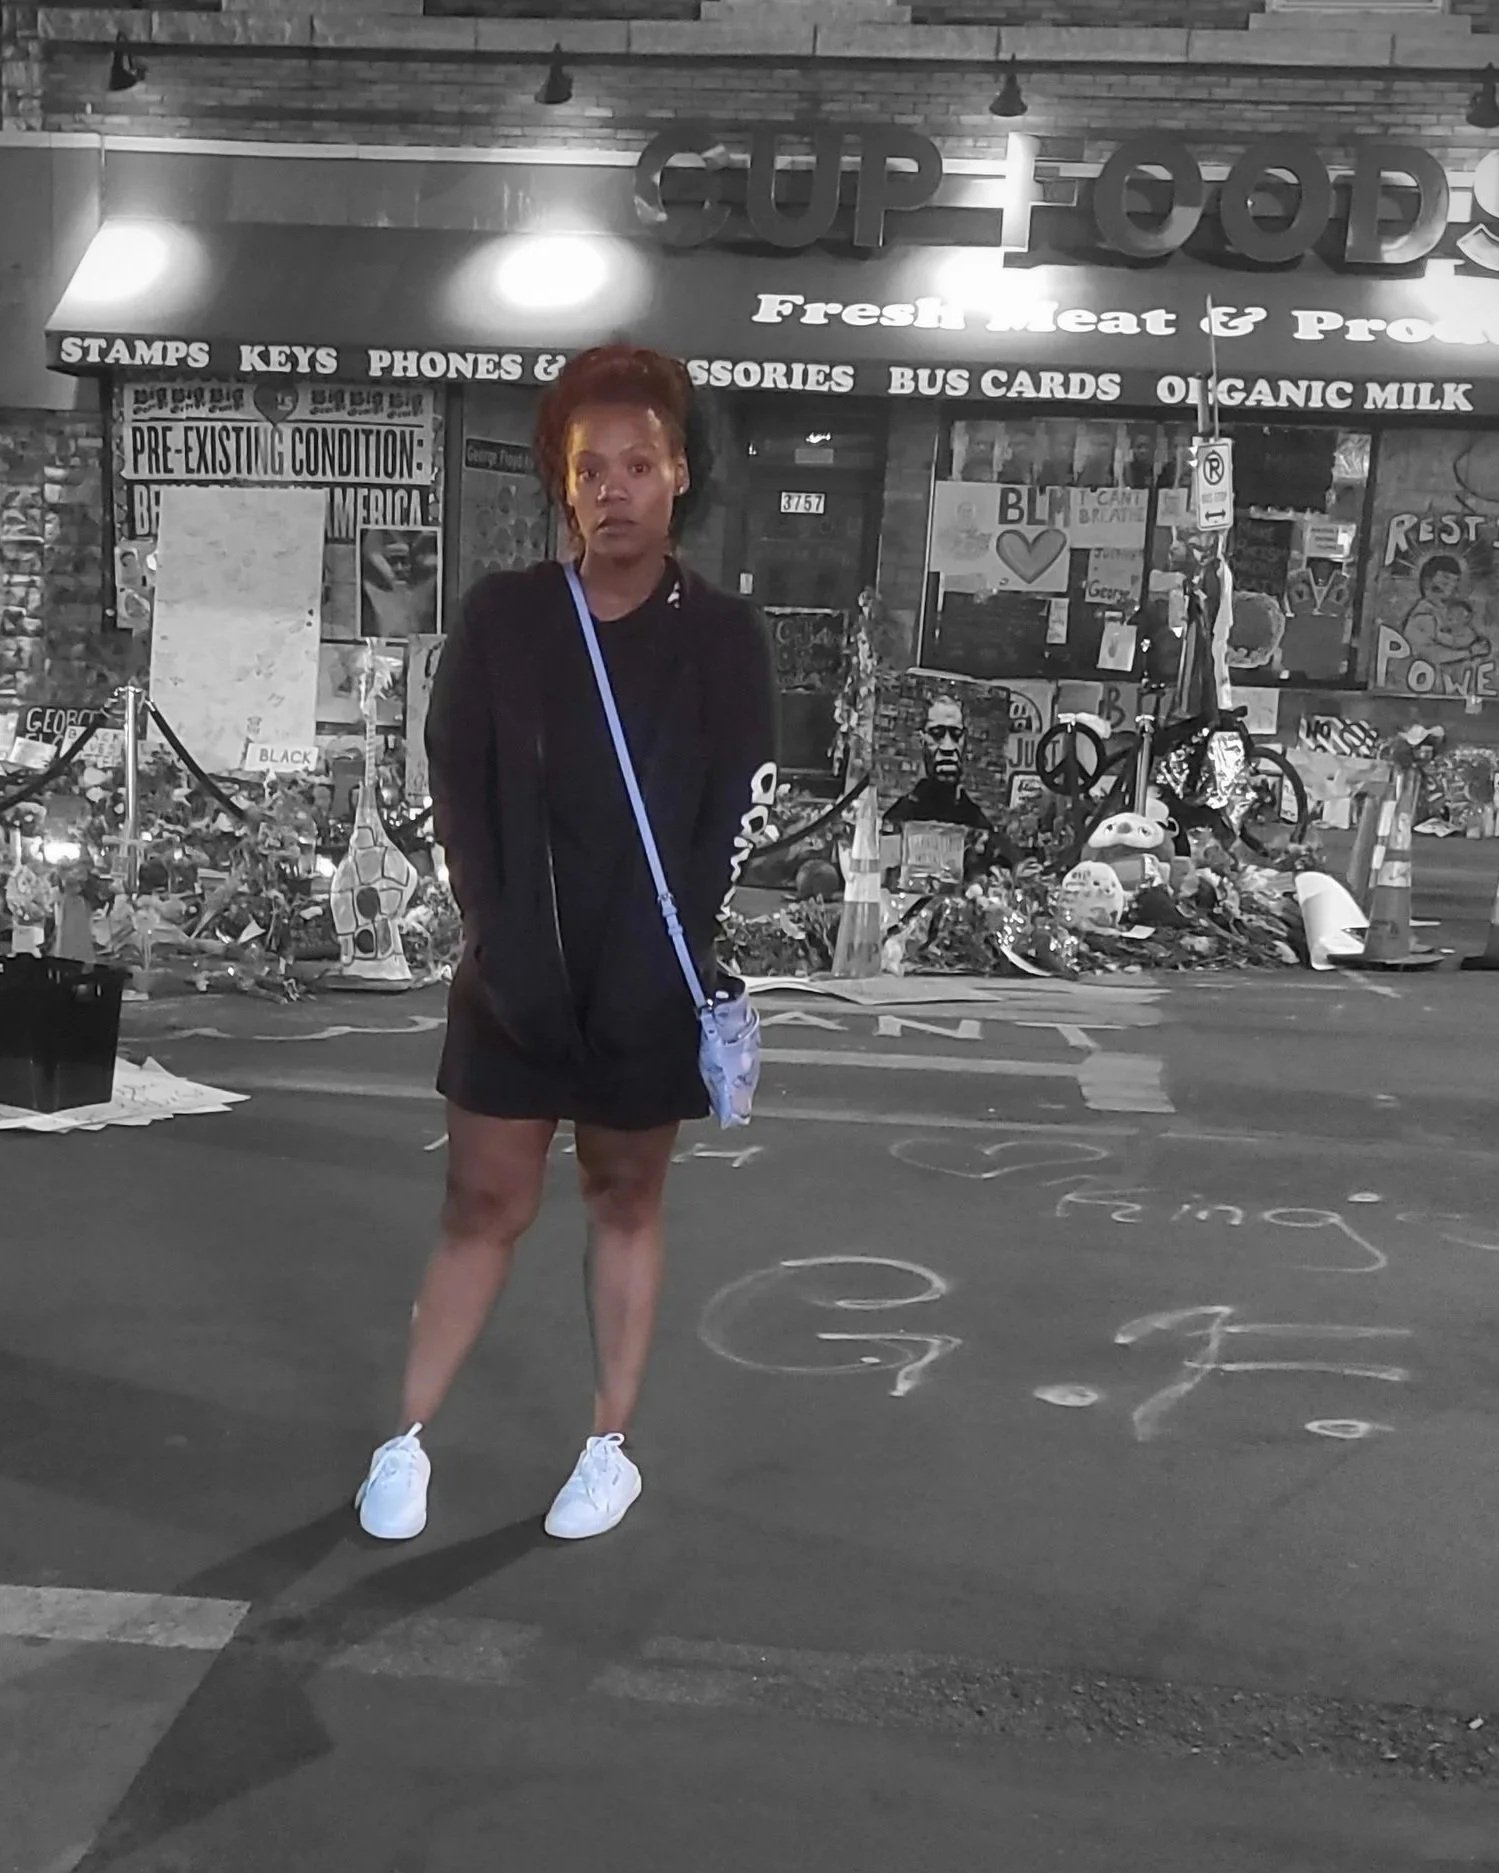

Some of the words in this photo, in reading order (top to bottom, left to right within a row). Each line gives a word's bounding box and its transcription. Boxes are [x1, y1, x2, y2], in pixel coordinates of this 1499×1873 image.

[634, 127, 943, 247] CUP
[752, 294, 965, 330] Fresh
[985, 300, 1176, 335] Meat
[1200, 306, 1267, 336] &
[61, 337, 209, 368] STAMPS
[239, 345, 338, 374] KEYS
[367, 349, 523, 380] PHONES
[533, 354, 567, 381] &
[687, 360, 855, 393] SSORIES
[888, 366, 970, 396] BUS
[980, 369, 1121, 400] CARDS
[1363, 382, 1474, 411] MILK
[132, 425, 284, 475] PRE-EXISTING
[291, 429, 424, 478] CONDITION:
[783, 495, 822, 511] 3757
[997, 487, 1071, 527] BLM
[1385, 514, 1486, 566] REST
[26, 707, 103, 735] GEOR
[259, 748, 311, 764] BLACK
